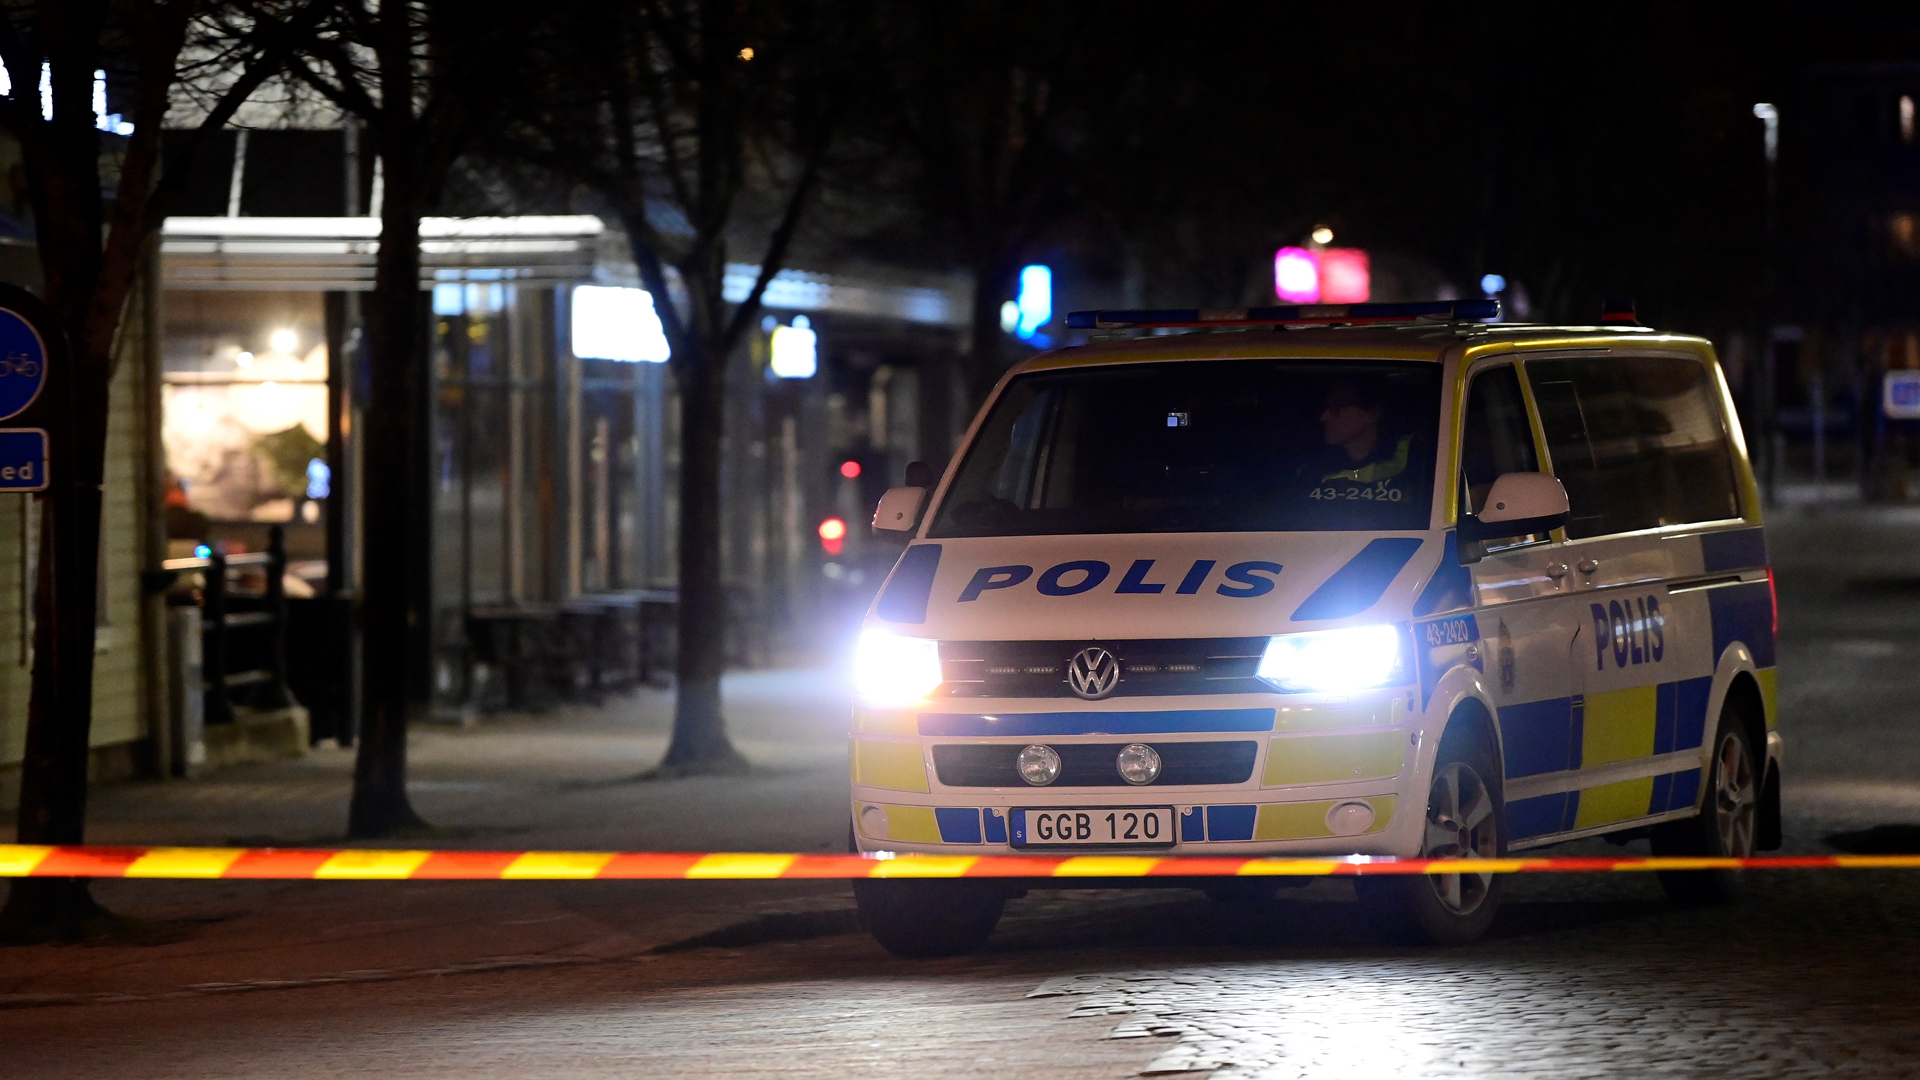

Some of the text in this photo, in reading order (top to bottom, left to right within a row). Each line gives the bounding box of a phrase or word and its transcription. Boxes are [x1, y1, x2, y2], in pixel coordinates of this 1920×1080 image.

[1309, 487, 1402, 502] 43-2420
[956, 559, 1284, 602] POLIS
[1427, 619, 1469, 645] 43-2420
[1590, 594, 1664, 671] POLIS
[1037, 812, 1159, 840] GGB 120
